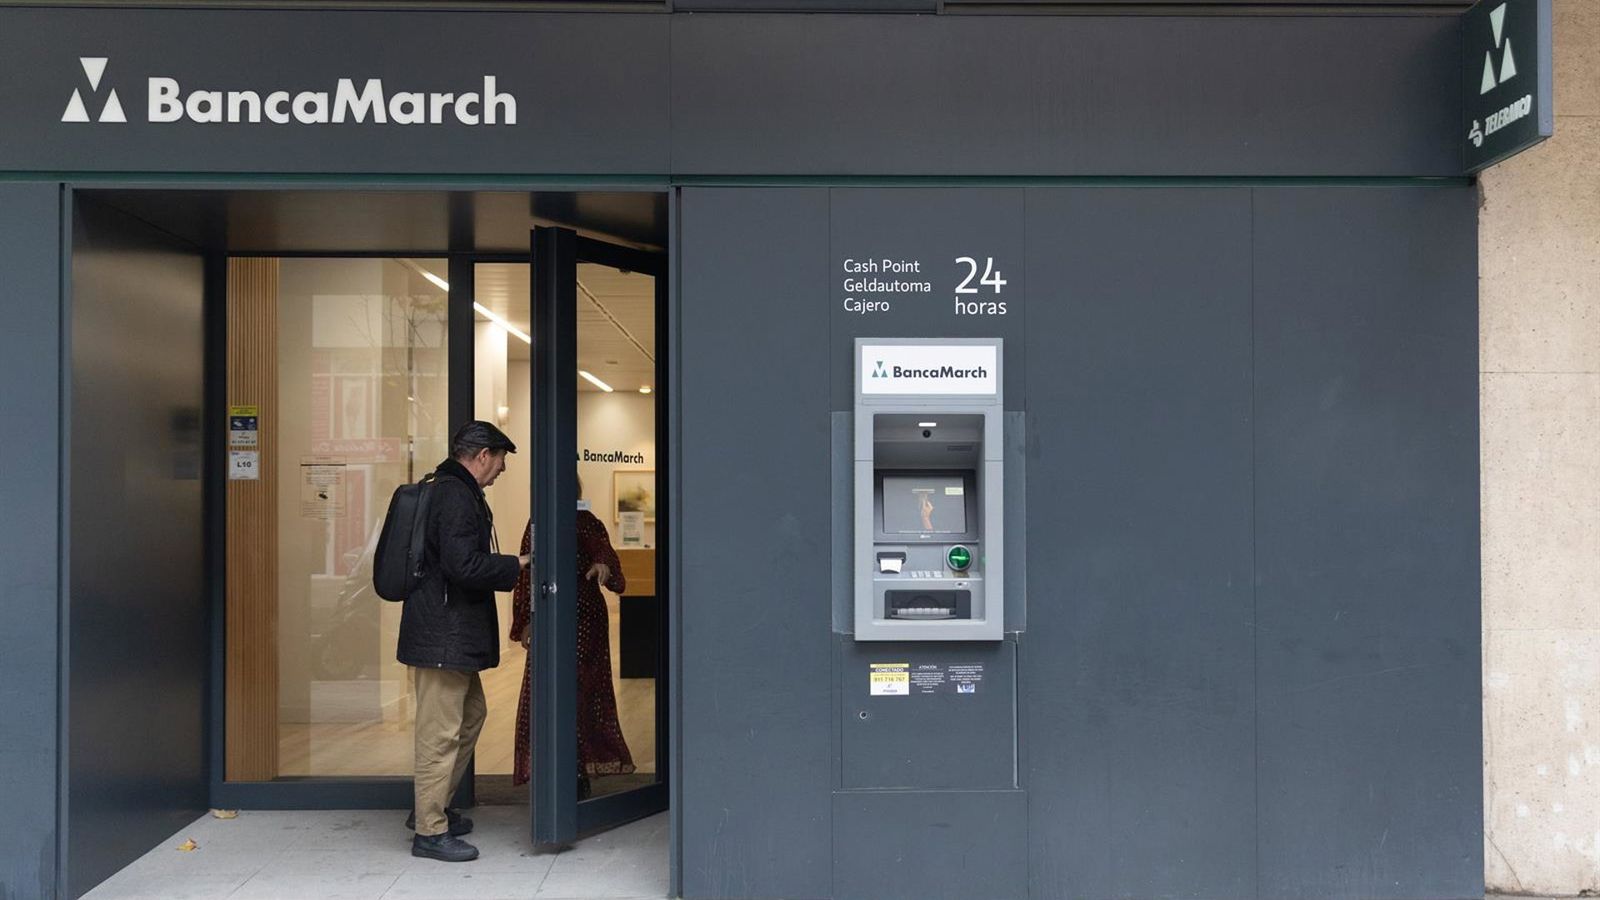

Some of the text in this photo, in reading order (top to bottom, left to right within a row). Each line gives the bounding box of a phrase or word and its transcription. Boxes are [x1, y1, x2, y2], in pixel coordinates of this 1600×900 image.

[149, 76, 516, 125] BancaMarch
[844, 259, 920, 272] Cash Point
[955, 257, 1007, 293] 24
[844, 278, 930, 292] Geldautoma
[844, 298, 889, 314] Cajero
[955, 296, 1007, 315] horas
[893, 366, 987, 378] BancaMarch
[584, 449, 643, 463] BancaMarch
